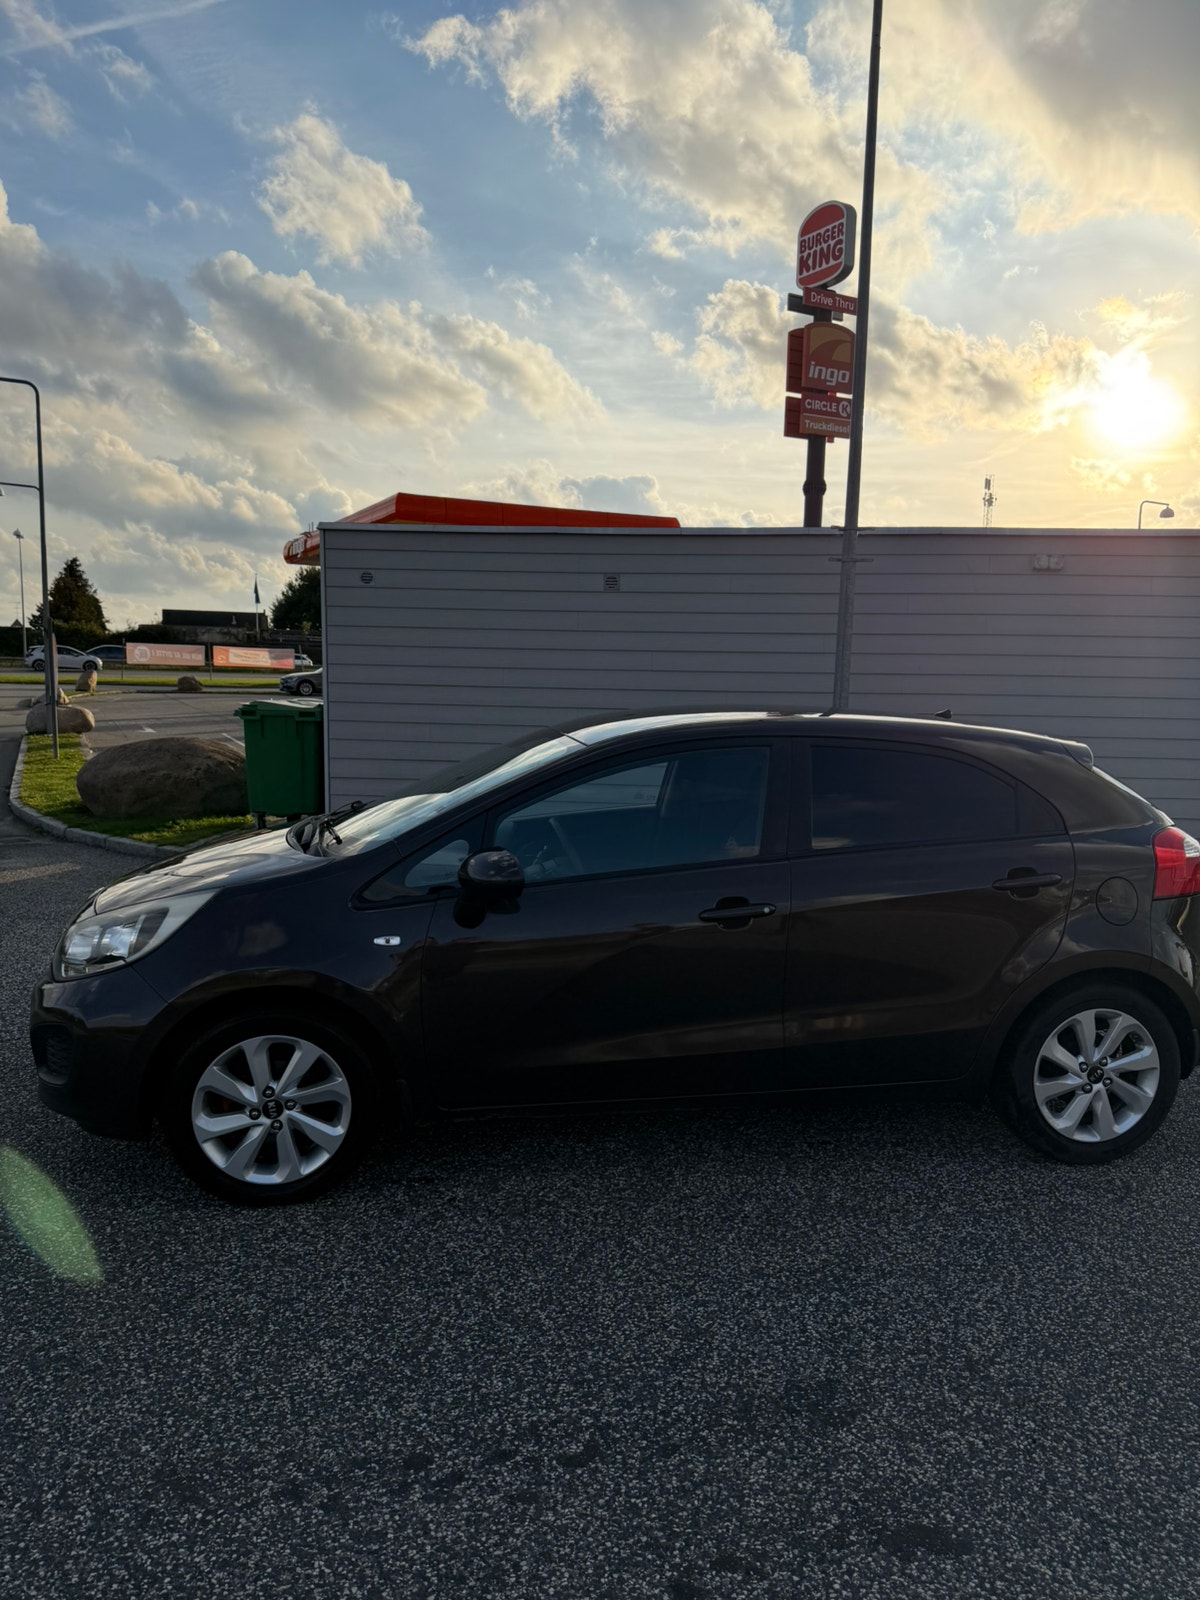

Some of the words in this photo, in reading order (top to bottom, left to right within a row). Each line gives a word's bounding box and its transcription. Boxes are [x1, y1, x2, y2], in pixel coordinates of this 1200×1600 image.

[799, 222, 844, 255] BURGER
[799, 238, 844, 276] KING
[810, 291, 833, 306] Drive
[834, 296, 854, 310] Thru
[808, 361, 850, 386] ingo
[804, 399, 837, 413] CIRCLE
[839, 401, 851, 417] K
[804, 420, 850, 434] Truckdiesel
[1089, 1069, 1103, 1082] KIA
[267, 1101, 278, 1119] KIA
